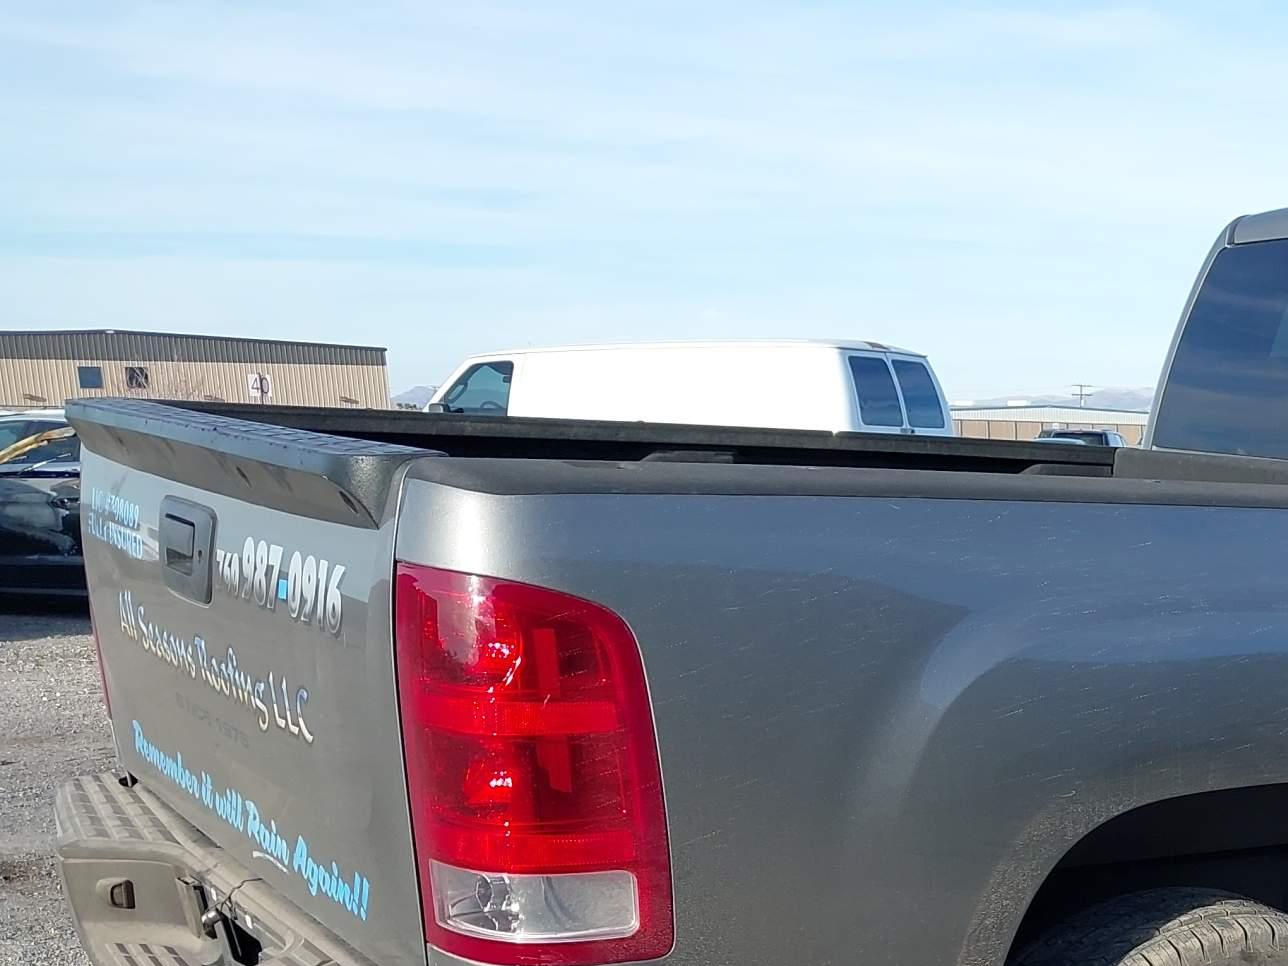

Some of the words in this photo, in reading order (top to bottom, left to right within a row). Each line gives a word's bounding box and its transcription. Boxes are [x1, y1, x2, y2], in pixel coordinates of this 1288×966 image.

[251, 377, 270, 394] 40
[109, 520, 143, 560] INSURED
[242, 536, 346, 634] 987-0916
[118, 589, 138, 641] All
[137, 605, 197, 679] Seasons
[194, 636, 269, 731] Roofing
[268, 671, 314, 743] LLC
[132, 719, 200, 799] Remember
[201, 770, 214, 809] it
[215, 787, 244, 832] will
[245, 800, 290, 866] Rain
[293, 834, 370, 921] Again!!
